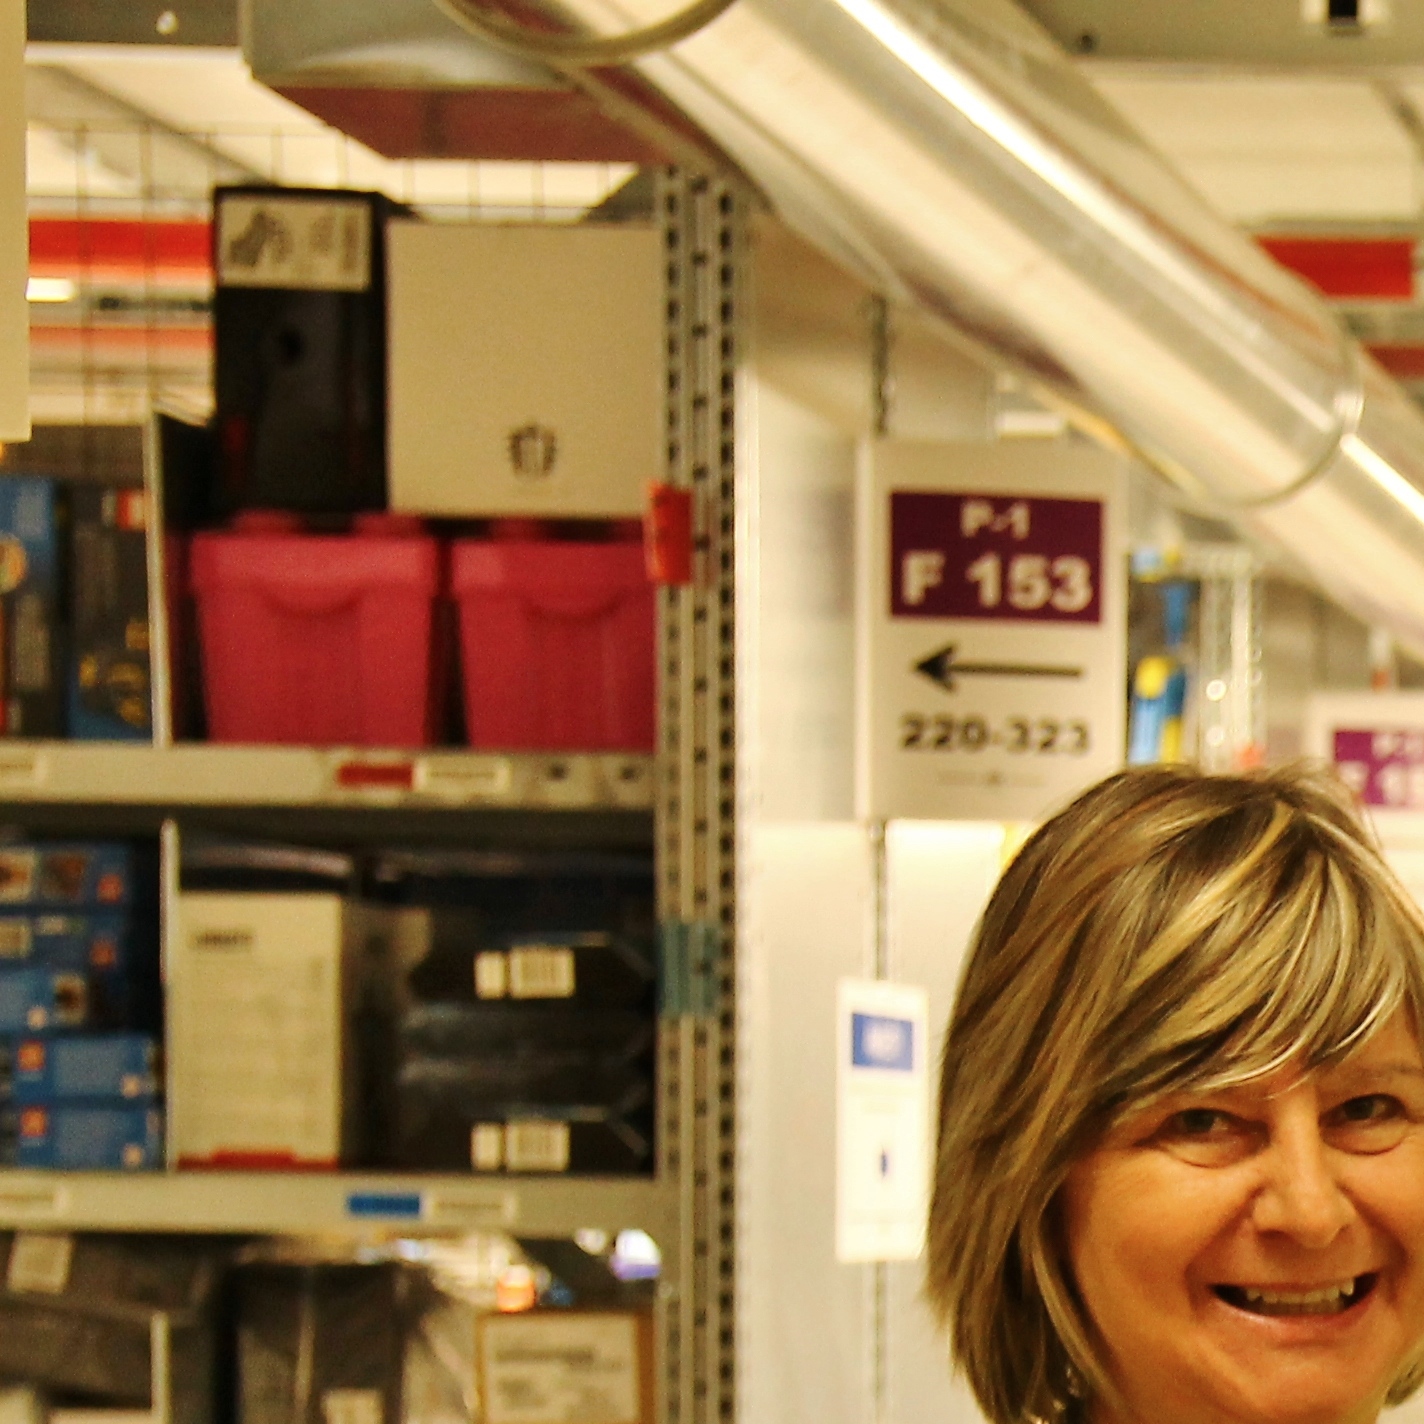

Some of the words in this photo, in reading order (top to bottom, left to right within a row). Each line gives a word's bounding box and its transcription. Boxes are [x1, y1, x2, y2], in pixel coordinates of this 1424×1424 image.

[959, 499, 1030, 541] P-1
[902, 550, 946, 605] F
[965, 551, 1094, 612] 153
[902, 713, 1091, 757] 220-323
